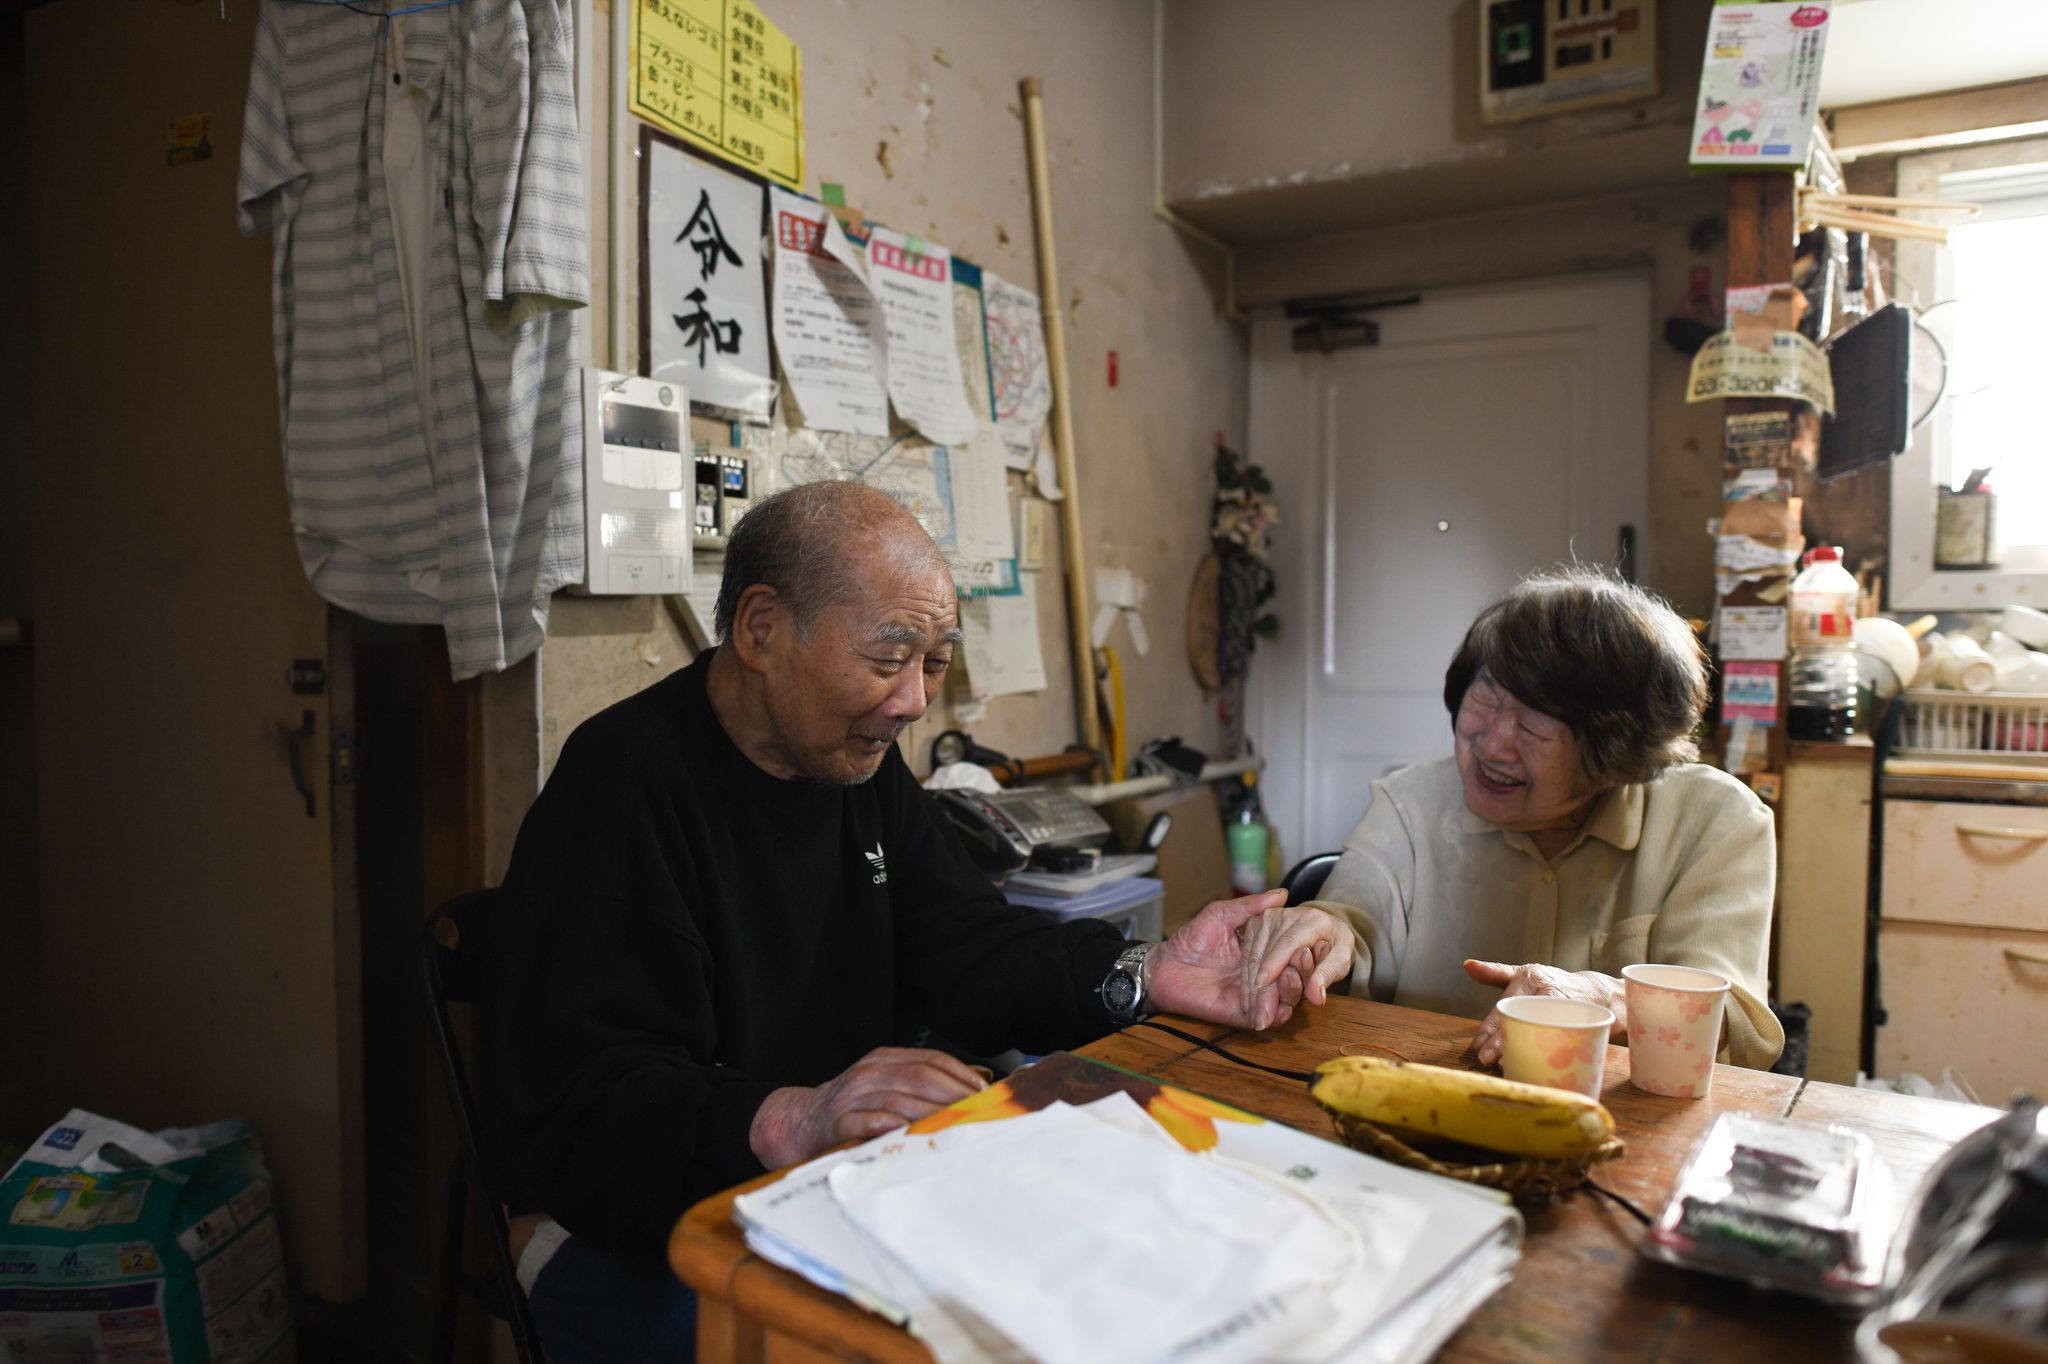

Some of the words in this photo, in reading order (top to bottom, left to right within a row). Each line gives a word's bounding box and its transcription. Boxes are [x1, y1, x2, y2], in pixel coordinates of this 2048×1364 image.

[674, 187, 744, 370] 令和
[60, 1251, 78, 1267] M
[132, 1253, 143, 1267] 2
